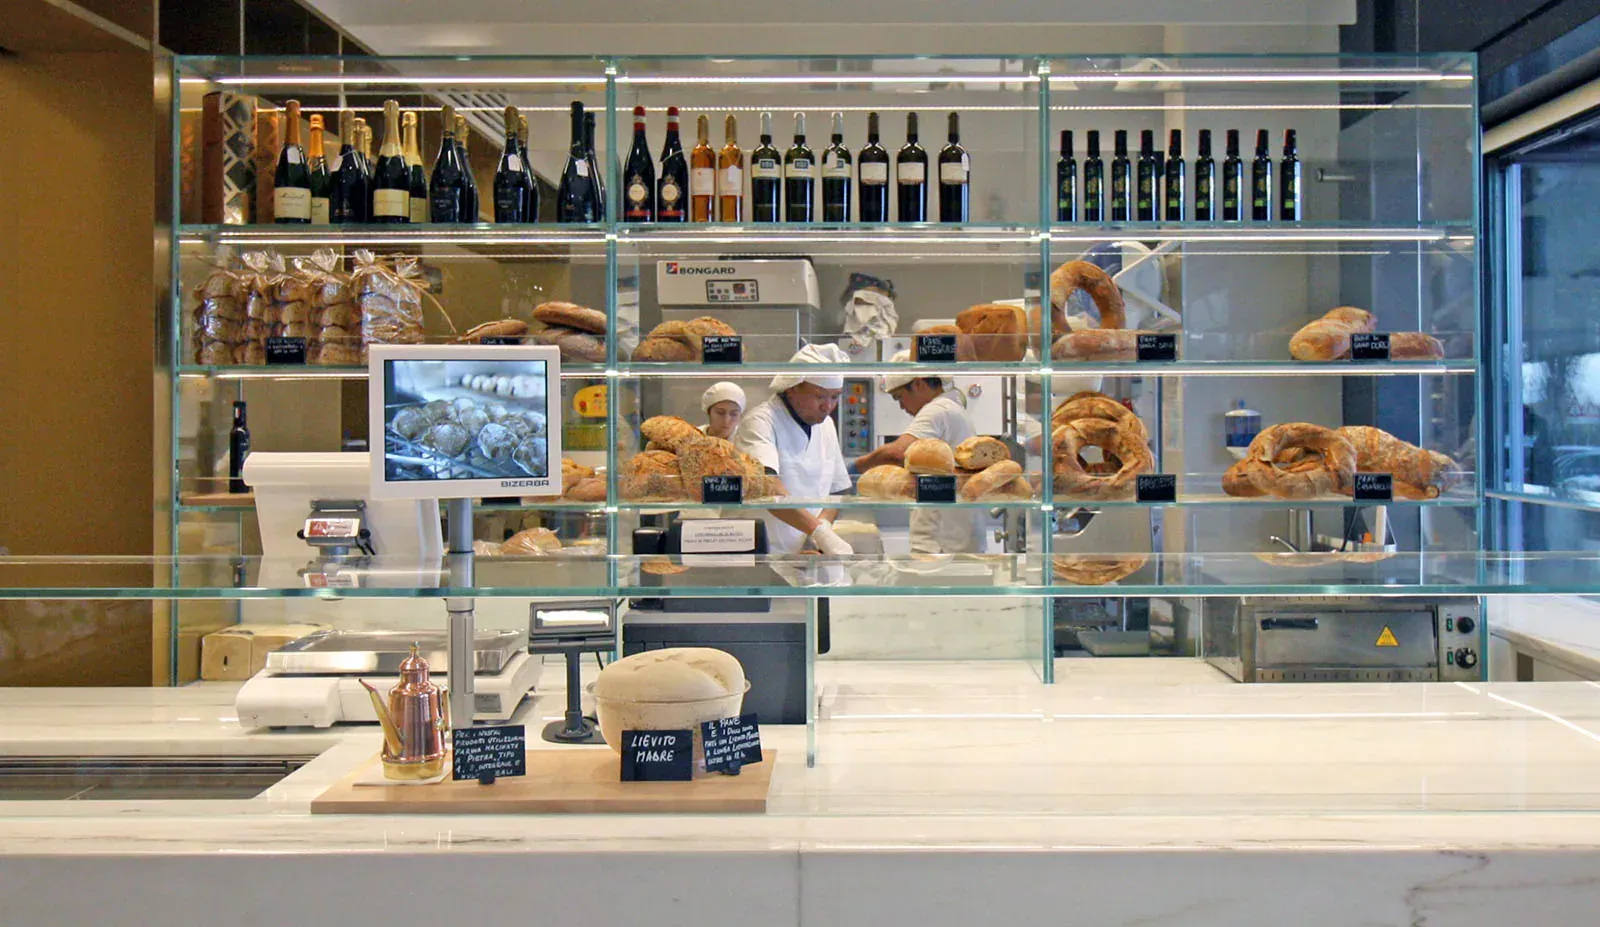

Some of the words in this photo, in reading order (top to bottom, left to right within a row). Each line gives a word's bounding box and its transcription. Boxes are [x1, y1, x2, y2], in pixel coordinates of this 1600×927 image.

[680, 267, 736, 275] BONGARD
[501, 480, 549, 488] BIZERBA
[720, 717, 741, 728] PANE
[631, 735, 676, 748] LIEVITO
[635, 750, 674, 763] MADRE
